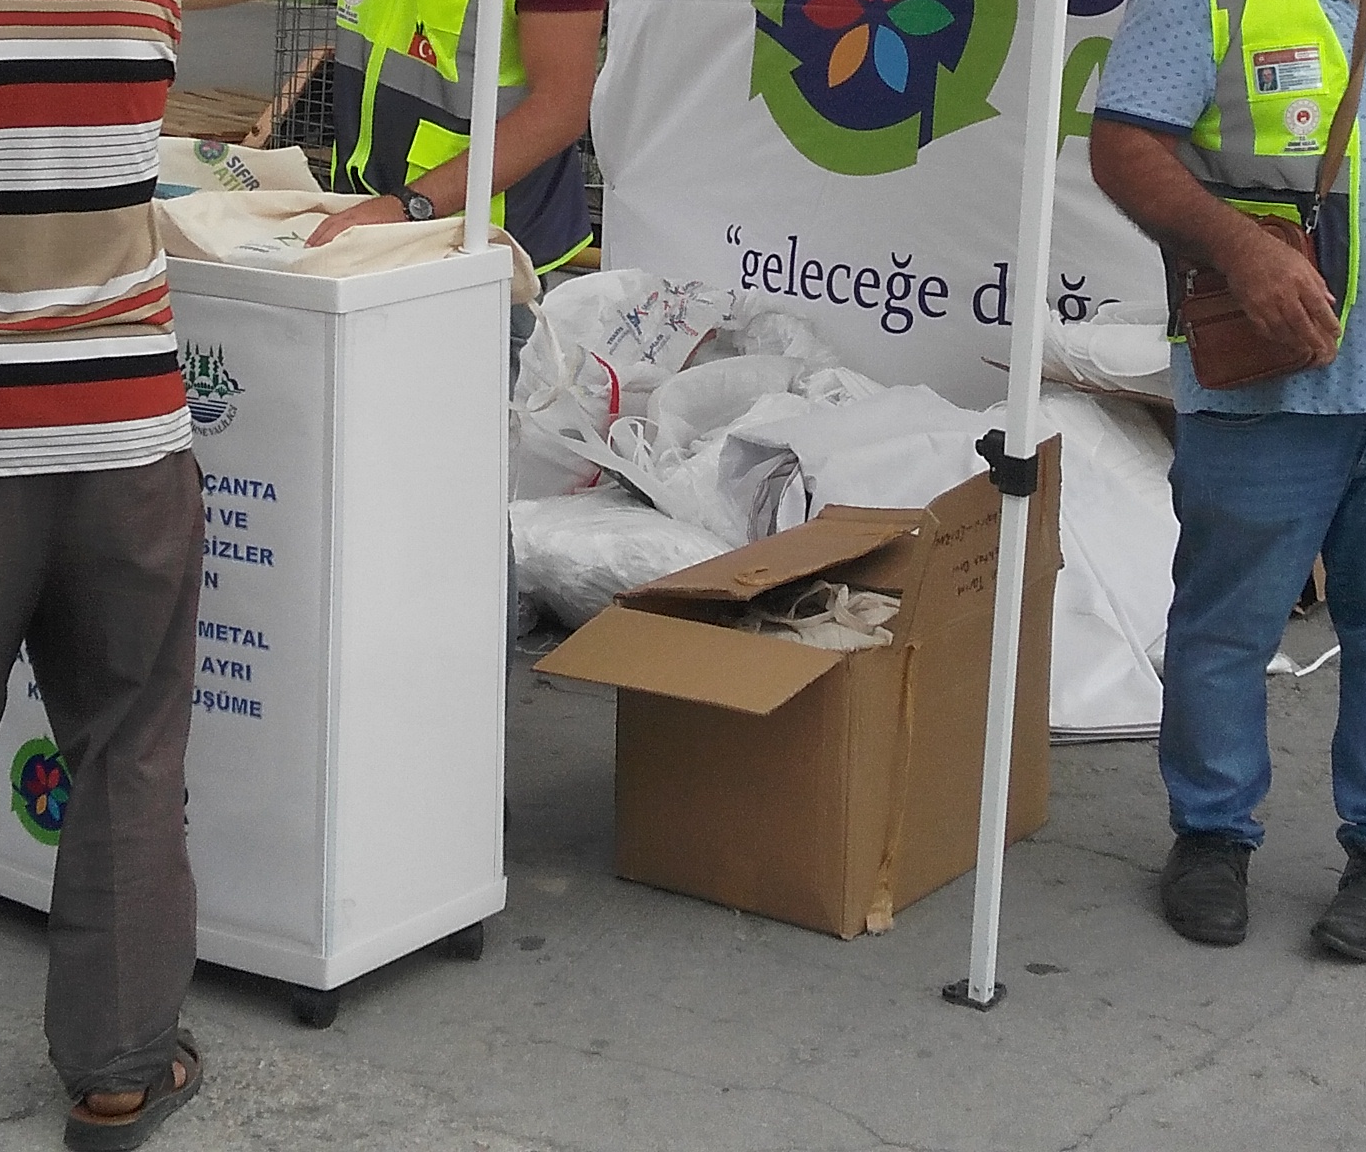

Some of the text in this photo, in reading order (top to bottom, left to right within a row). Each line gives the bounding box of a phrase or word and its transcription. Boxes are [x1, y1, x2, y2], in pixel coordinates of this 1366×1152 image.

[204, 473, 278, 502] ÇANTA
[219, 508, 249, 529] VE
[198, 619, 270, 650] METAL
[201, 656, 253, 683] AYRI
